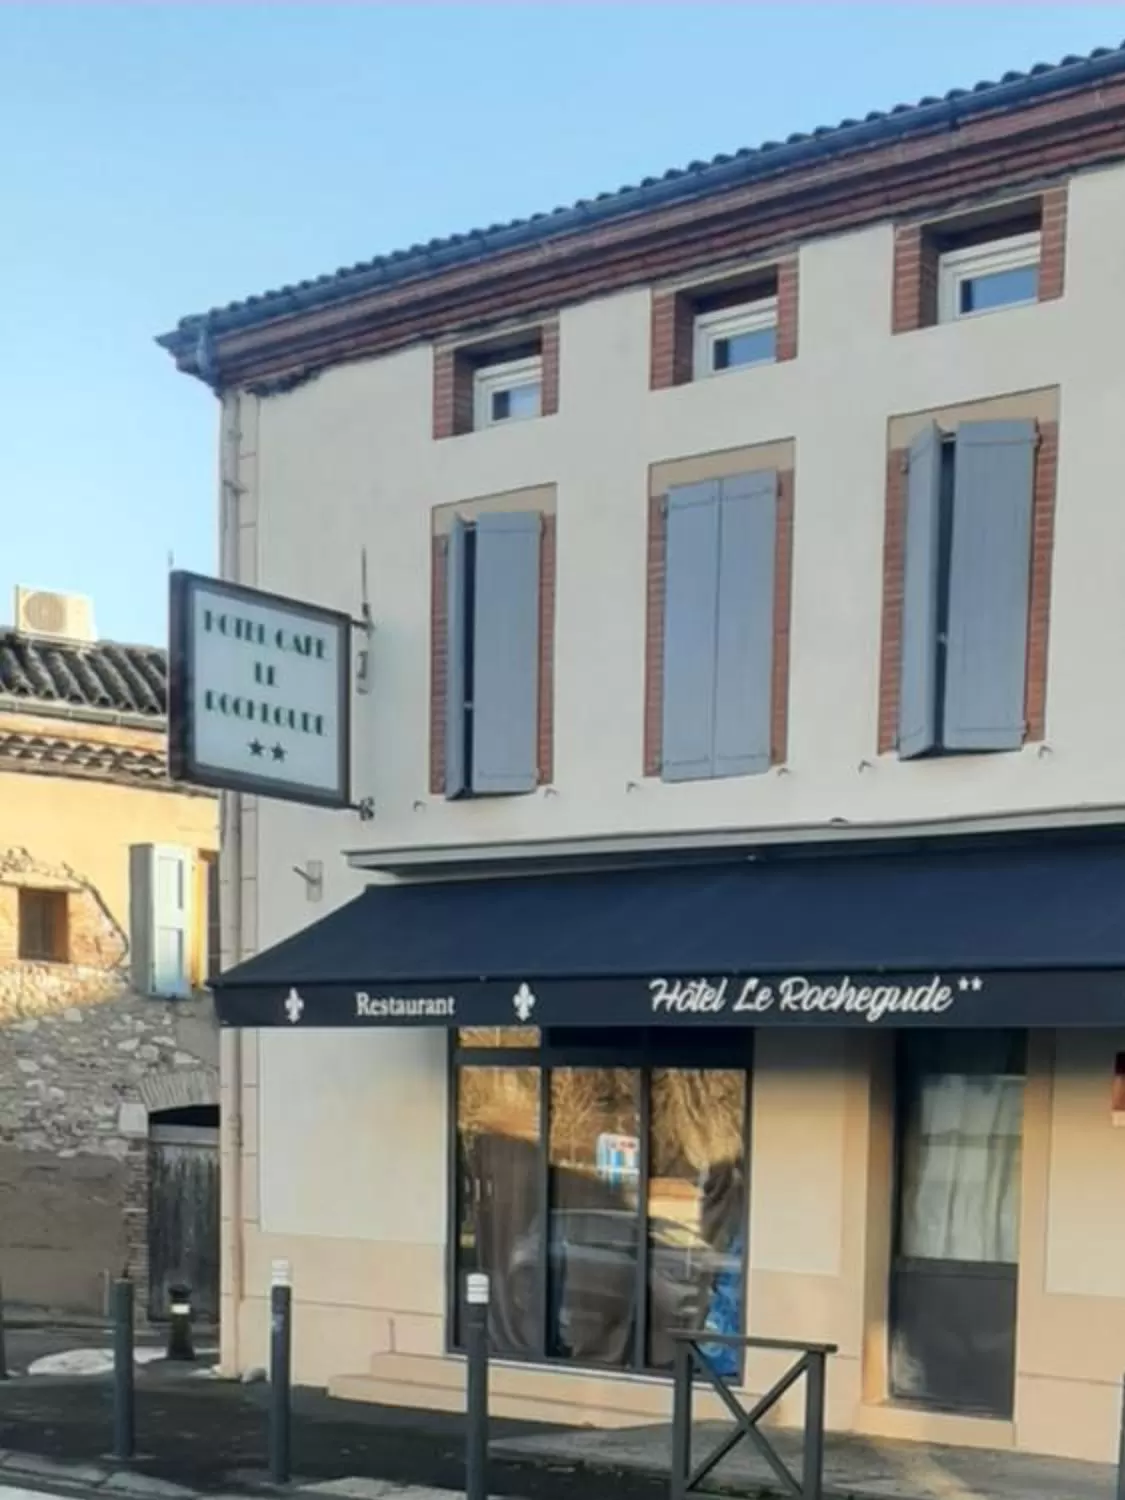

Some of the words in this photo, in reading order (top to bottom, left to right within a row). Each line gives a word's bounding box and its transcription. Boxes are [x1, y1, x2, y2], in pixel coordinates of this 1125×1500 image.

[355, 991, 455, 1016] Restaurant
[649, 976, 728, 1012] Hôtel
[733, 977, 774, 1011] Le
[779, 975, 953, 1022] Rochegude
